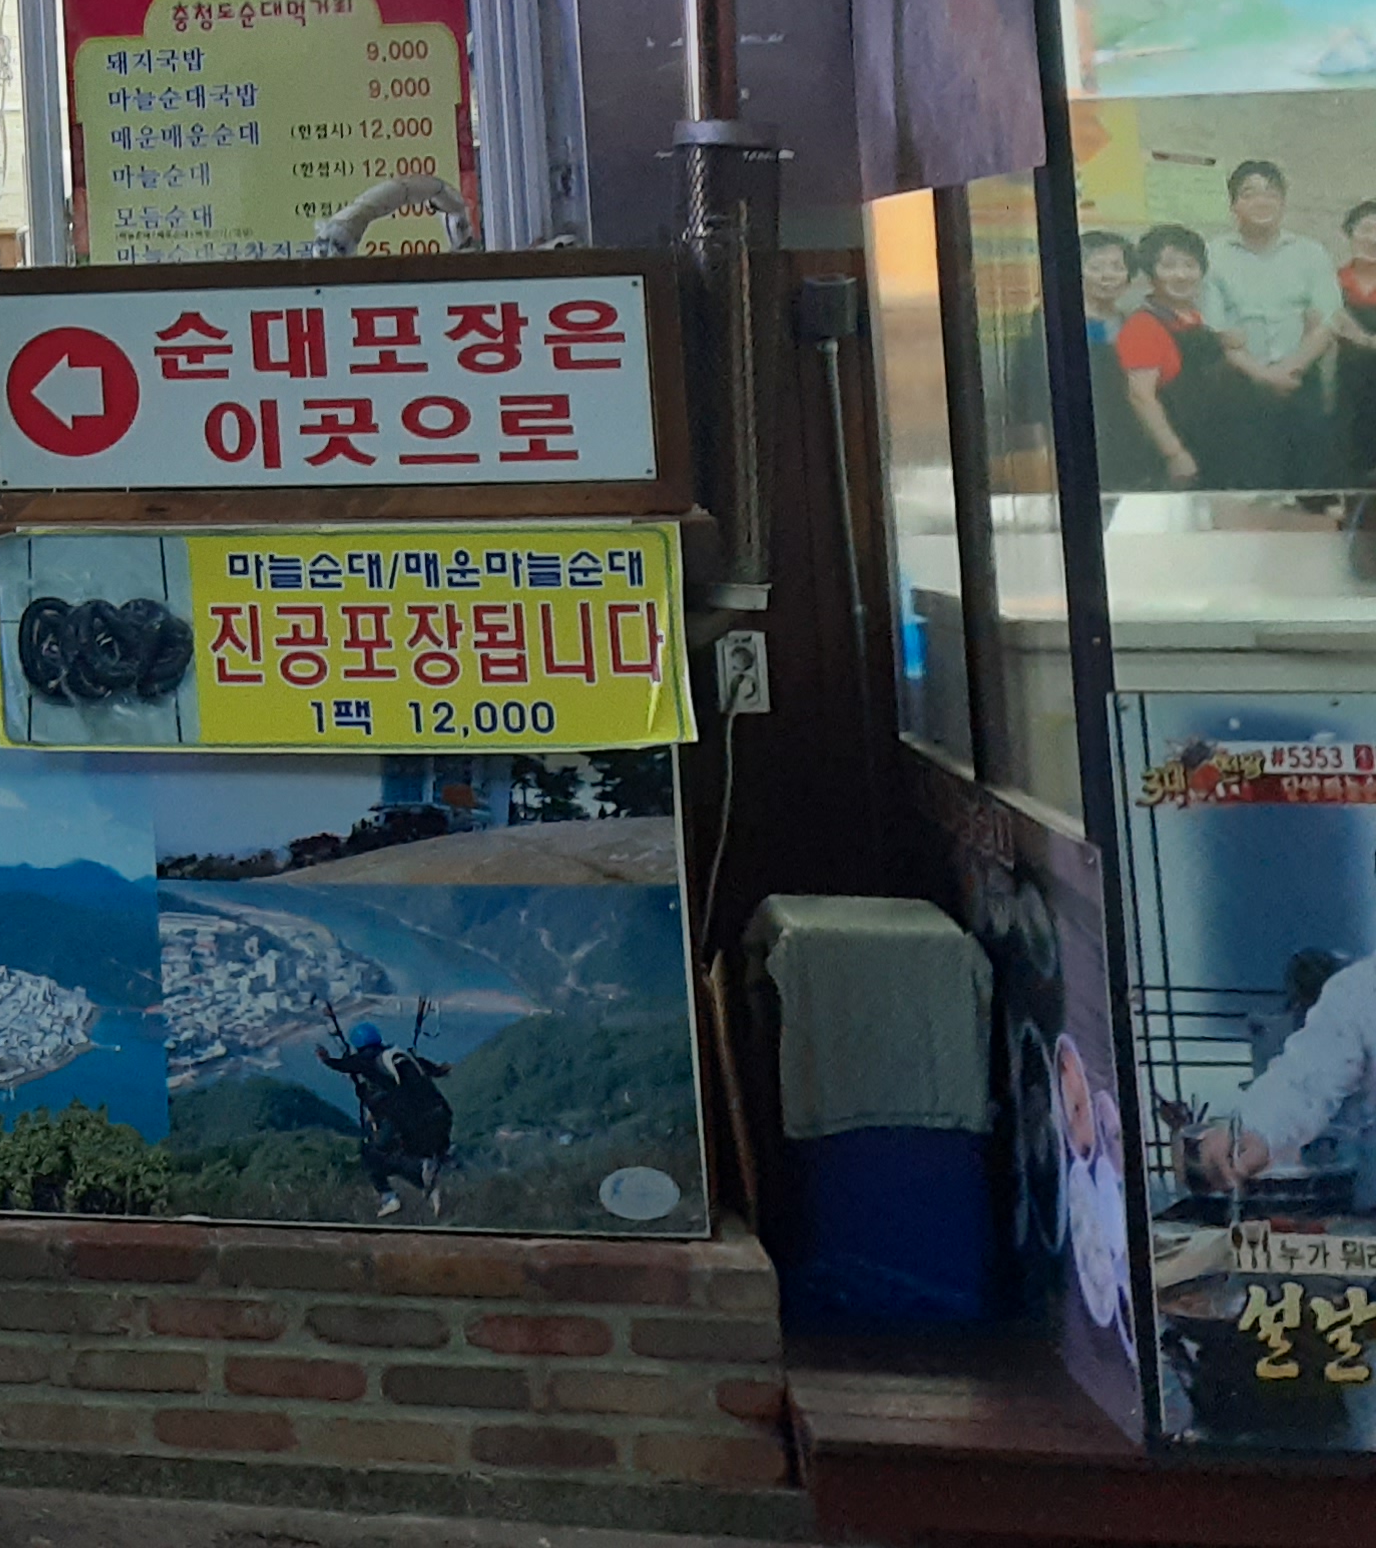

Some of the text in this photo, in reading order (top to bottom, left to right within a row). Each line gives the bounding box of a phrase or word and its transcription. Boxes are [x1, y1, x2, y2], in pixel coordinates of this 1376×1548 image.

[106, 46, 205, 76] 돼지국밥
[108, 82, 259, 113] 마늘순대국밥
[111, 120, 260, 151] 매운매운순대
[113, 161, 210, 190] 마늘순대
[115, 204, 213, 229] 모듬순대
[153, 299, 626, 381] 순대포장은
[204, 393, 580, 470] 이곳으로
[228, 548, 644, 592] 마늘순대/매운마늘순대
[209, 602, 665, 688] 진공포장됩니다
[310, 699, 556, 738] 1팩 12,000
[1271, 746, 1343, 769] #5353
[1279, 1240, 1330, 1270] 누가
